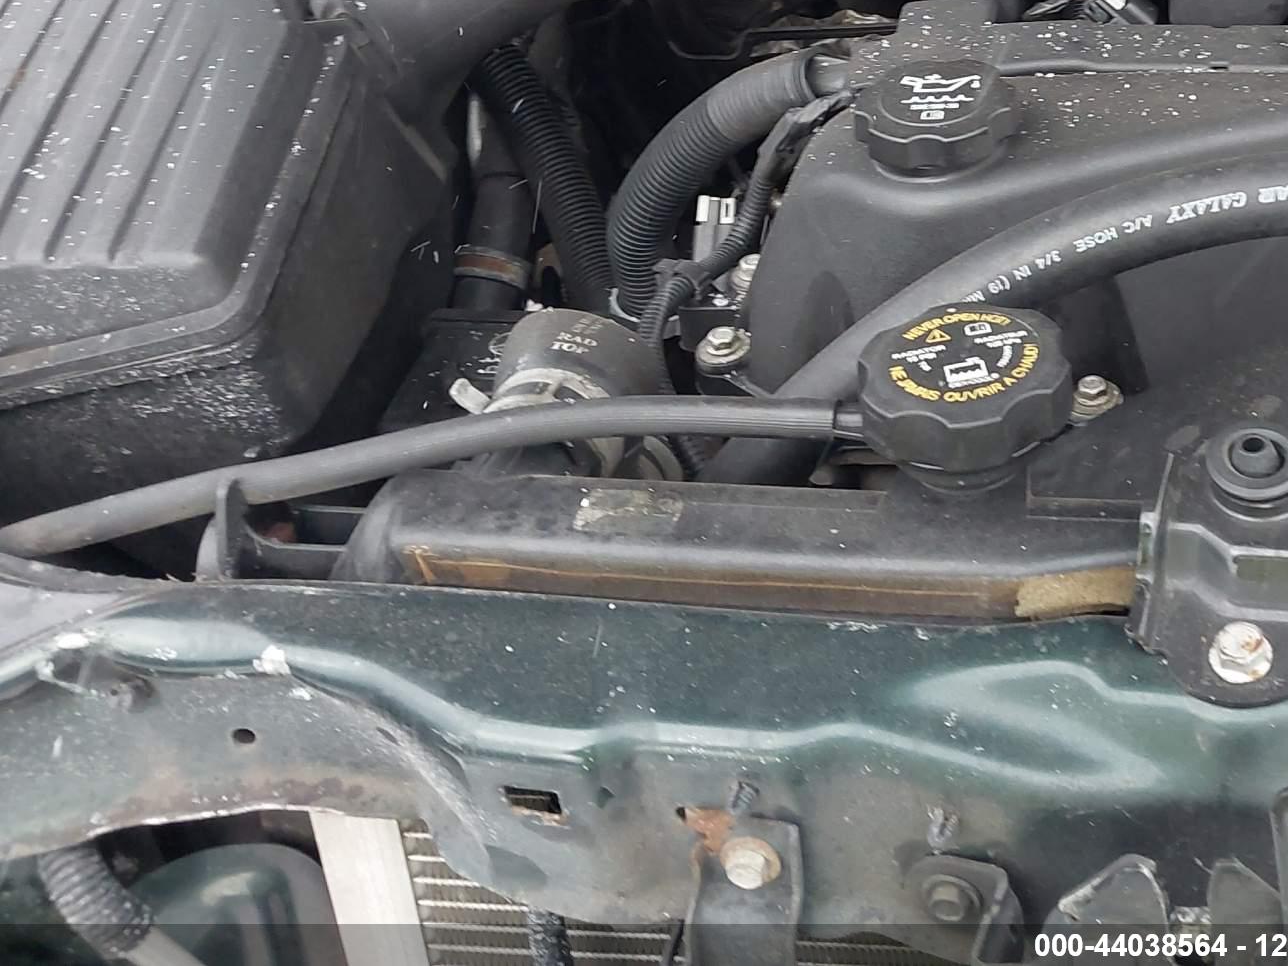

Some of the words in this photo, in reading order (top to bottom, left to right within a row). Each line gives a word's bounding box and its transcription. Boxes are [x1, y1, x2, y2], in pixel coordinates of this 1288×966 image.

[1167, 191, 1247, 224] GALAXY
[1121, 214, 1153, 234] A/C
[1072, 227, 1119, 252] HOSE
[1034, 250, 1062, 269] 3/4
[1012, 265, 1032, 281] IN
[987, 275, 1011, 294] (19
[902, 318, 945, 340] NEVER
[943, 313, 980, 324] OPEN
[557, 331, 598, 347] RAD
[943, 383, 1006, 402] OUVRIR
